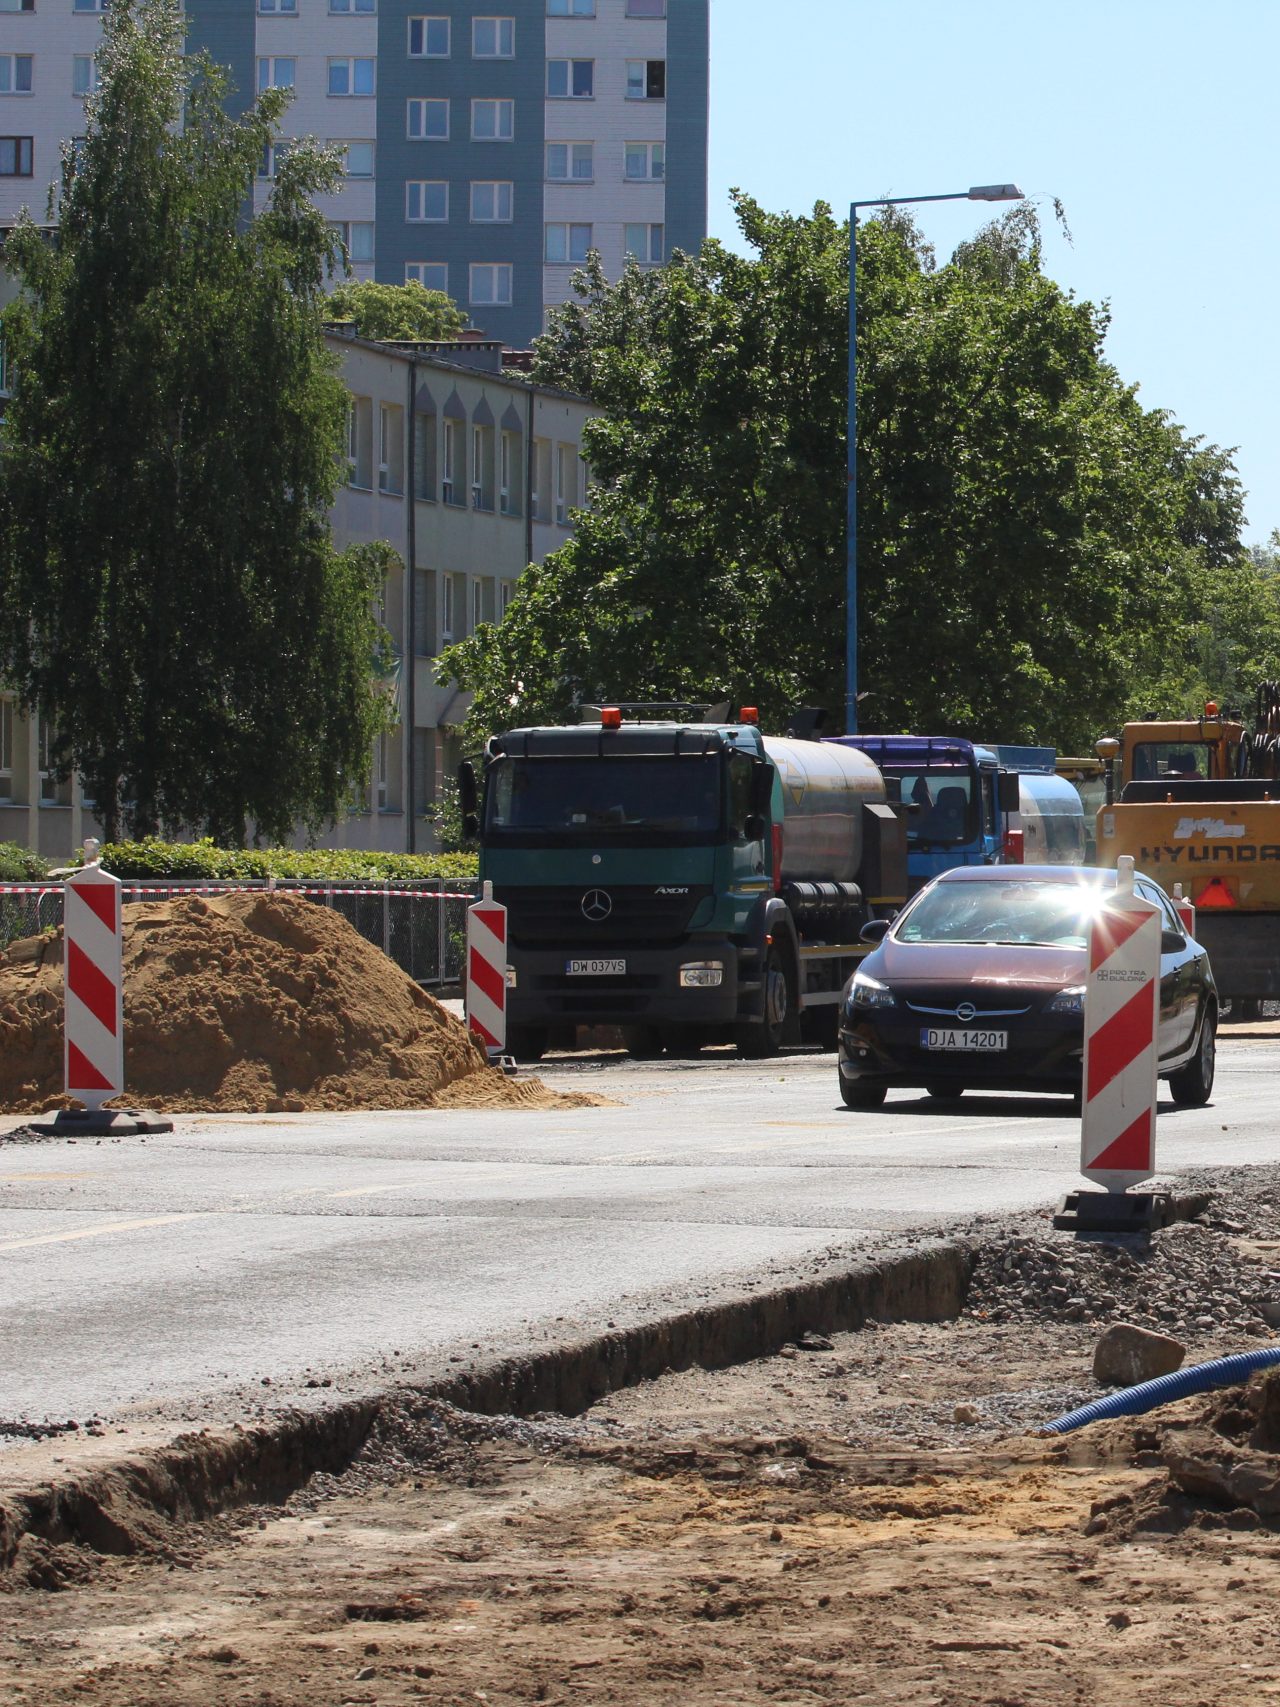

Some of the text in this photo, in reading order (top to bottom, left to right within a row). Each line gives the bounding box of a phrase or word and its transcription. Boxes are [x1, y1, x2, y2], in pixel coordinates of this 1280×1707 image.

[572, 961, 588, 972] DW
[591, 960, 625, 972] 037VS
[929, 1031, 1004, 1047] DJA 14201
